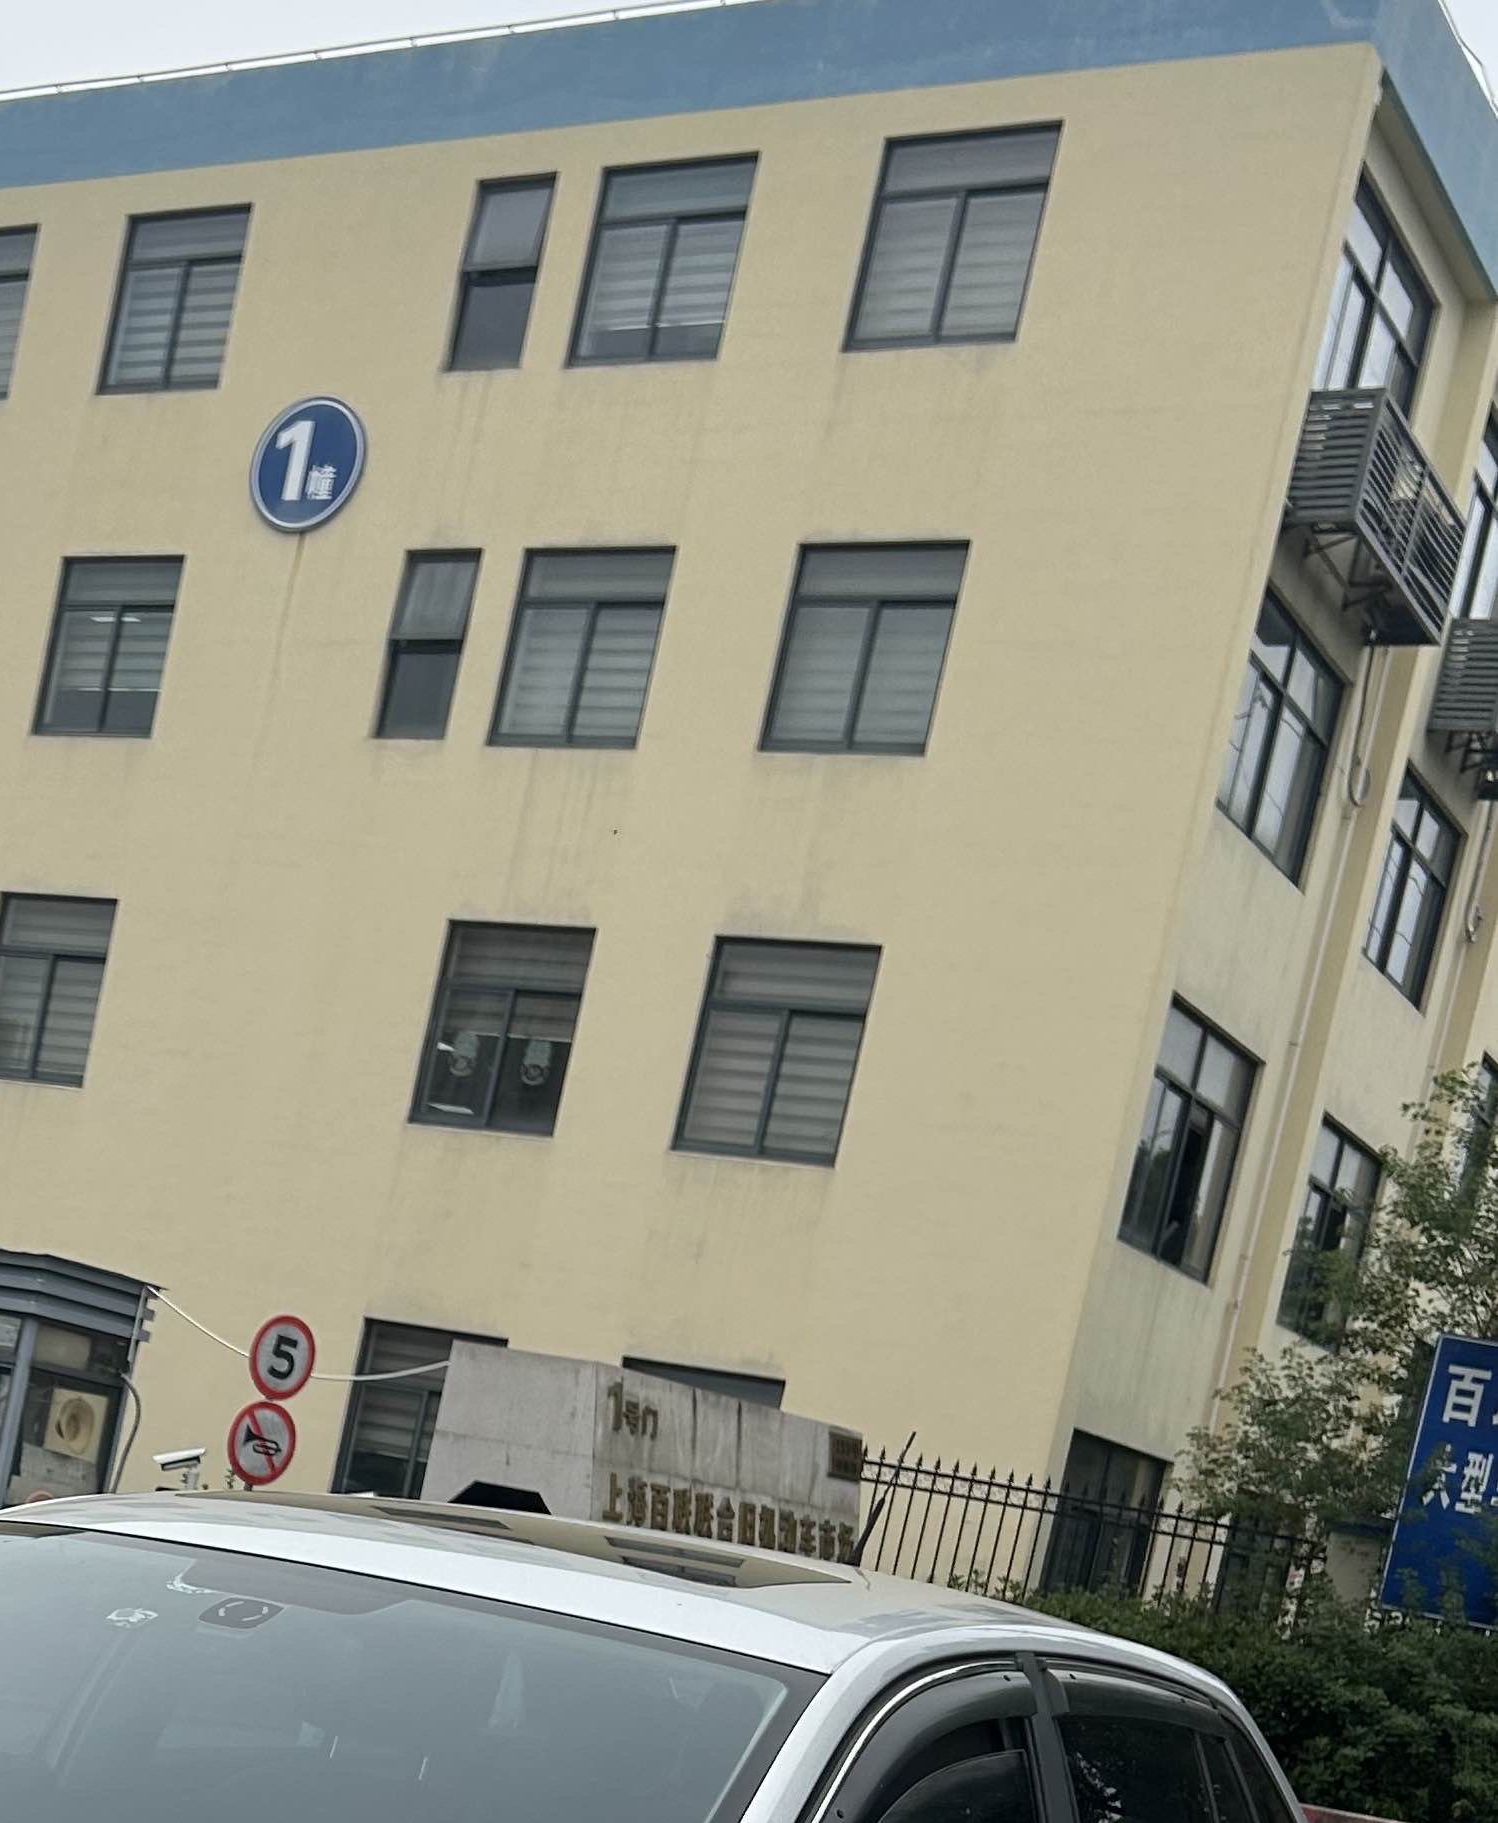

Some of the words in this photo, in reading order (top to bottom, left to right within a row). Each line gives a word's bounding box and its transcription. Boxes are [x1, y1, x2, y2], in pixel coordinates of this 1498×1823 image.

[268, 1335, 299, 1380] 5
[607, 1381, 659, 1440] 1号门
[1442, 1364, 1498, 1428] 百
